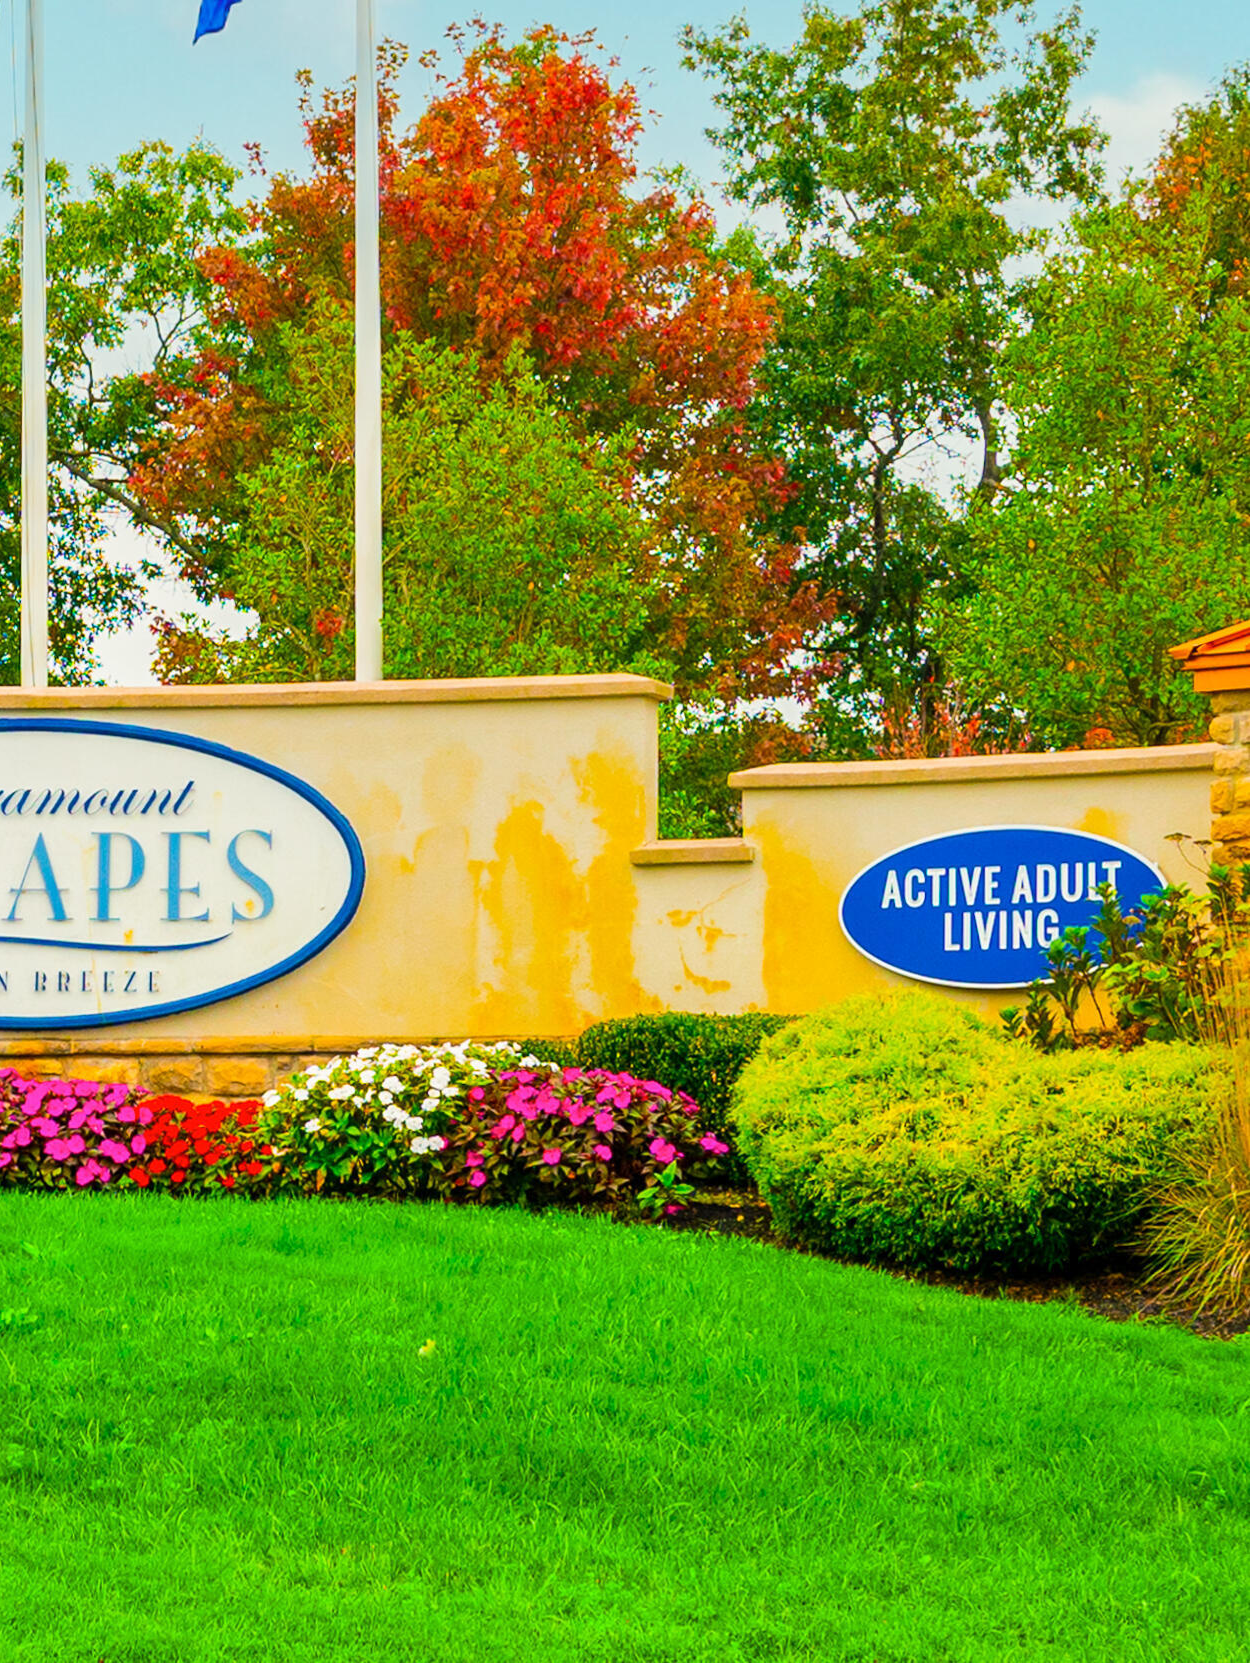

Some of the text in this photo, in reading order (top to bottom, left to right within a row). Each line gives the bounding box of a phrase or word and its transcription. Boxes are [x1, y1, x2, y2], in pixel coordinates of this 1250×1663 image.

[881, 861, 1122, 909] ACTIVE ADULT
[944, 908, 1060, 951] LIVING
[34, 969, 163, 993] BREEZE
